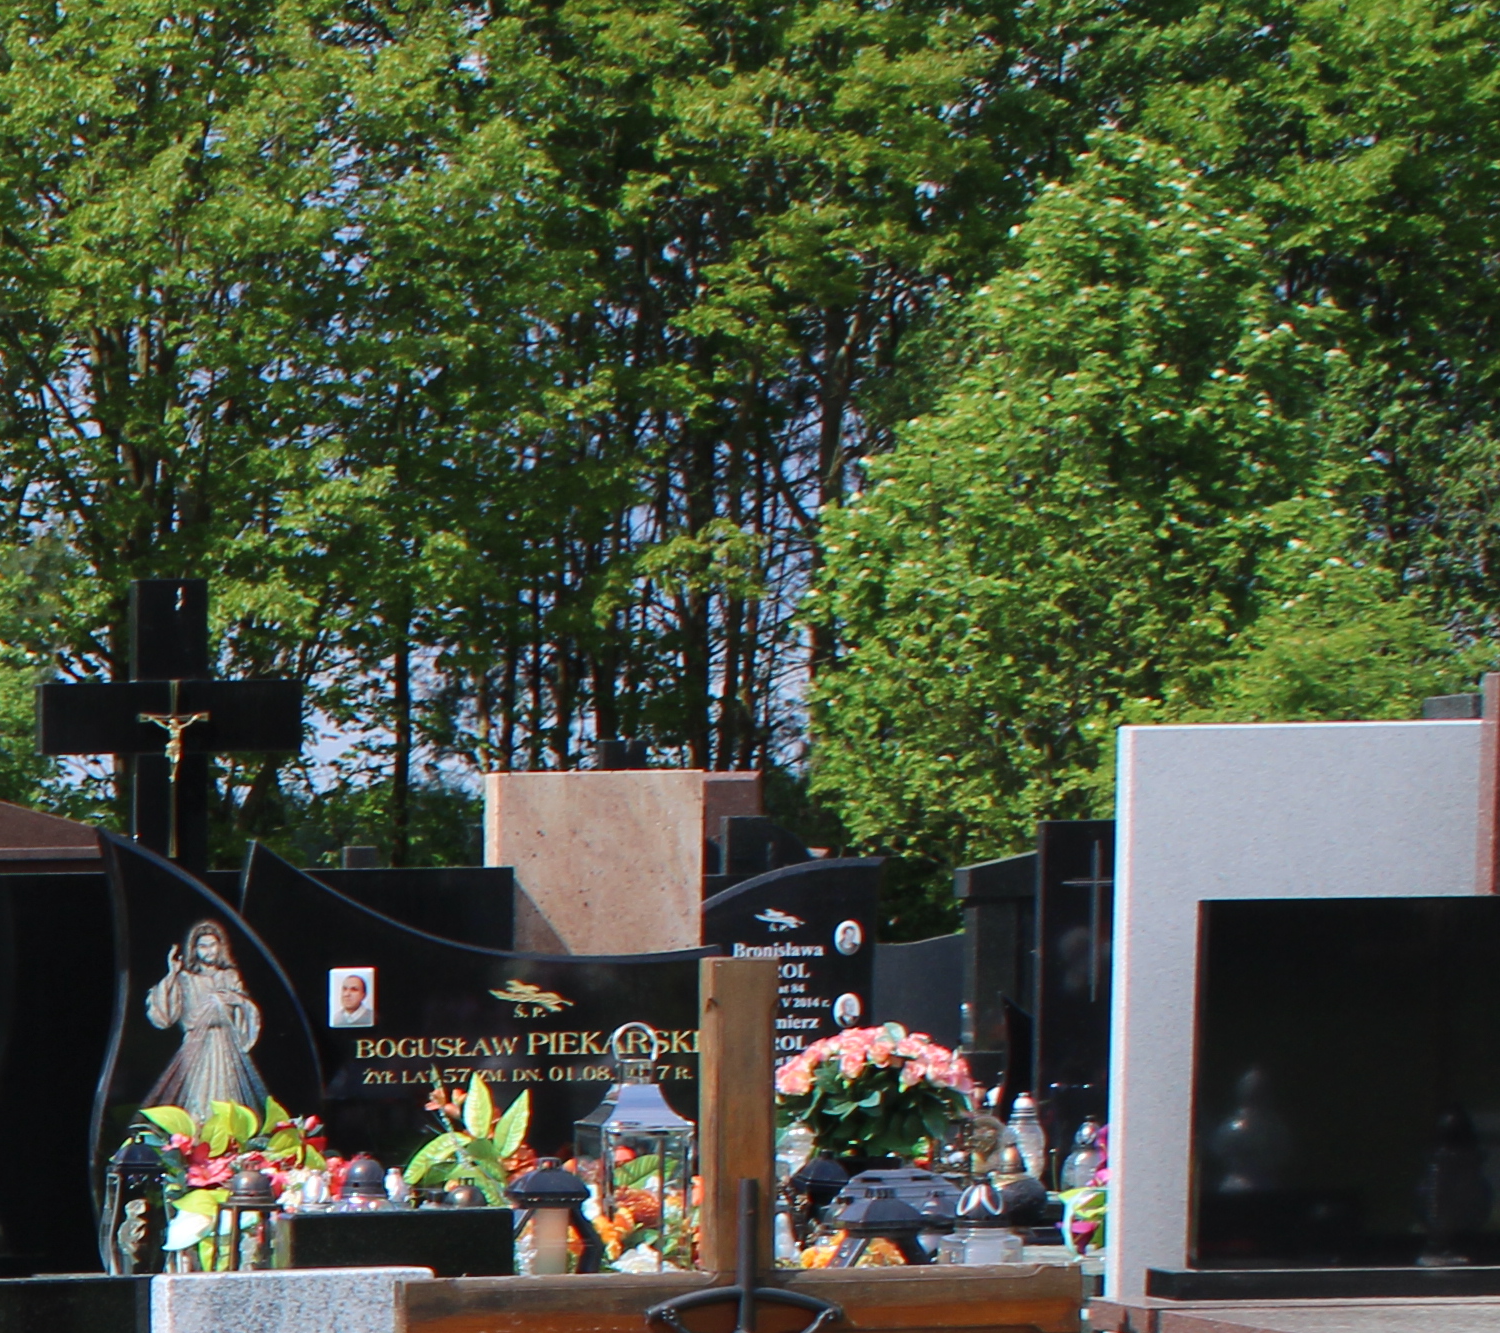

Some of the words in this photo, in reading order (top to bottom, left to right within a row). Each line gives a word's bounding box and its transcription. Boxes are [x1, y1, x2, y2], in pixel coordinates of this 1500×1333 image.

[733, 942, 825, 958] Bronisława
[778, 963, 811, 979] OL
[356, 1036, 519, 1059] BOGUSŁAW
[526, 1030, 700, 1056] PIEKARSKI
[775, 1035, 810, 1051] OL
[443, 1068, 472, 1083] 57
[512, 1069, 544, 1082] DN.
